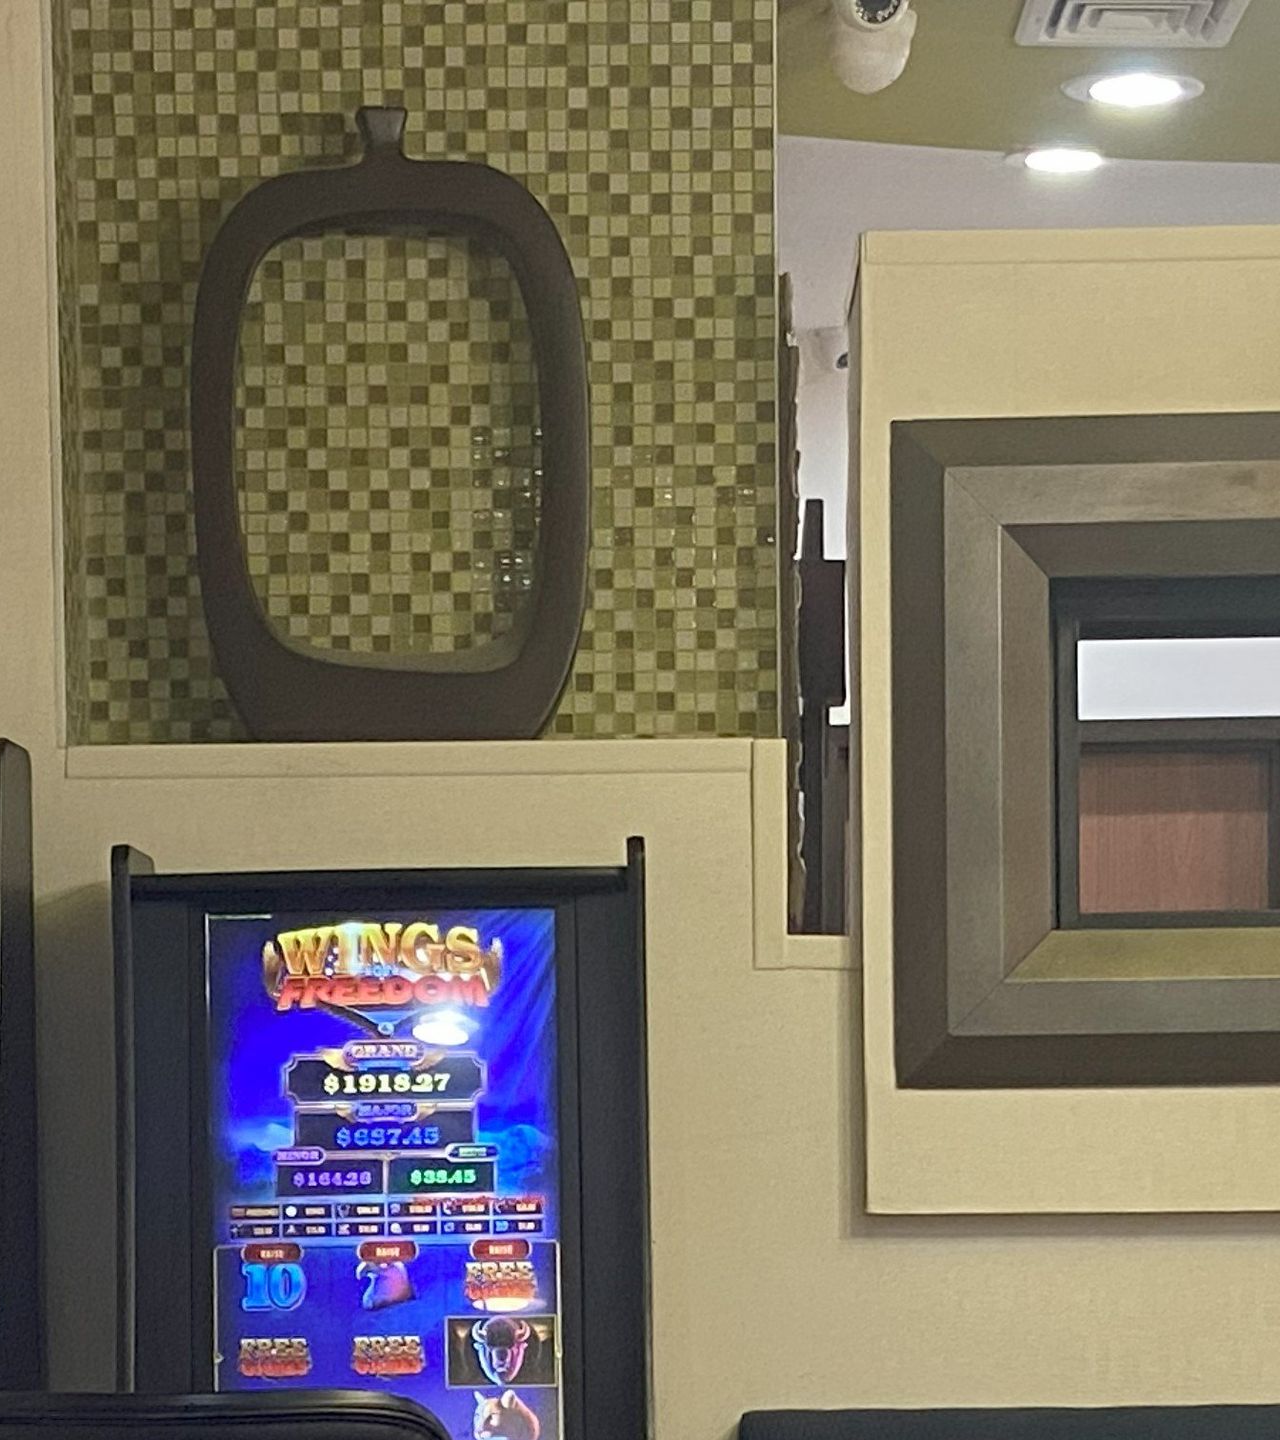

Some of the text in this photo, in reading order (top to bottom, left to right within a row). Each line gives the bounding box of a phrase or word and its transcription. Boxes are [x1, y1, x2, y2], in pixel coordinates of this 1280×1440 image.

[277, 922, 486, 976] WINGS
[277, 974, 491, 1011] FREEDOM
[351, 1044, 419, 1058] GRAND
[241, 1262, 307, 1312] 10
